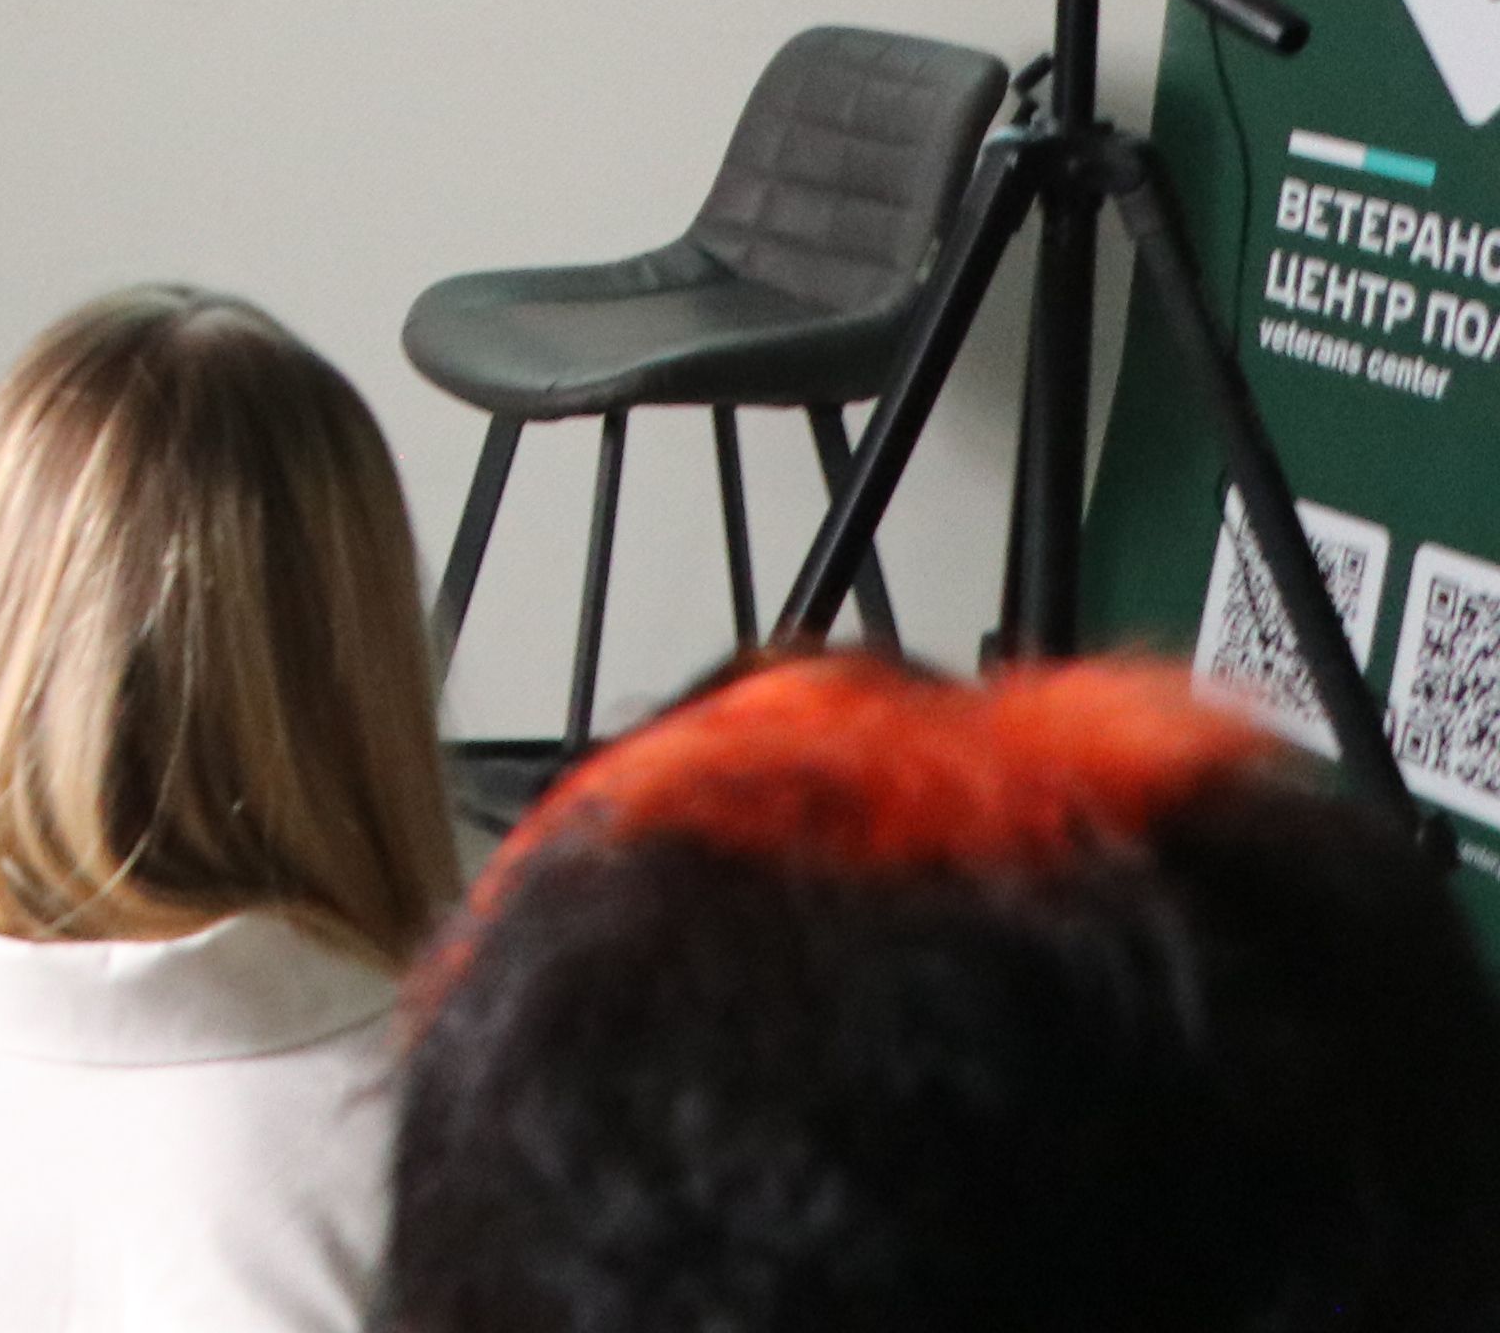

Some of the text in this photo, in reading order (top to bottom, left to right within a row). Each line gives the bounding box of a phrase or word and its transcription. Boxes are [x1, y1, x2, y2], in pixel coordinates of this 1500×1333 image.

[1264, 247, 1417, 334] ЦЕНТР
[1259, 317, 1451, 401] veterans center
